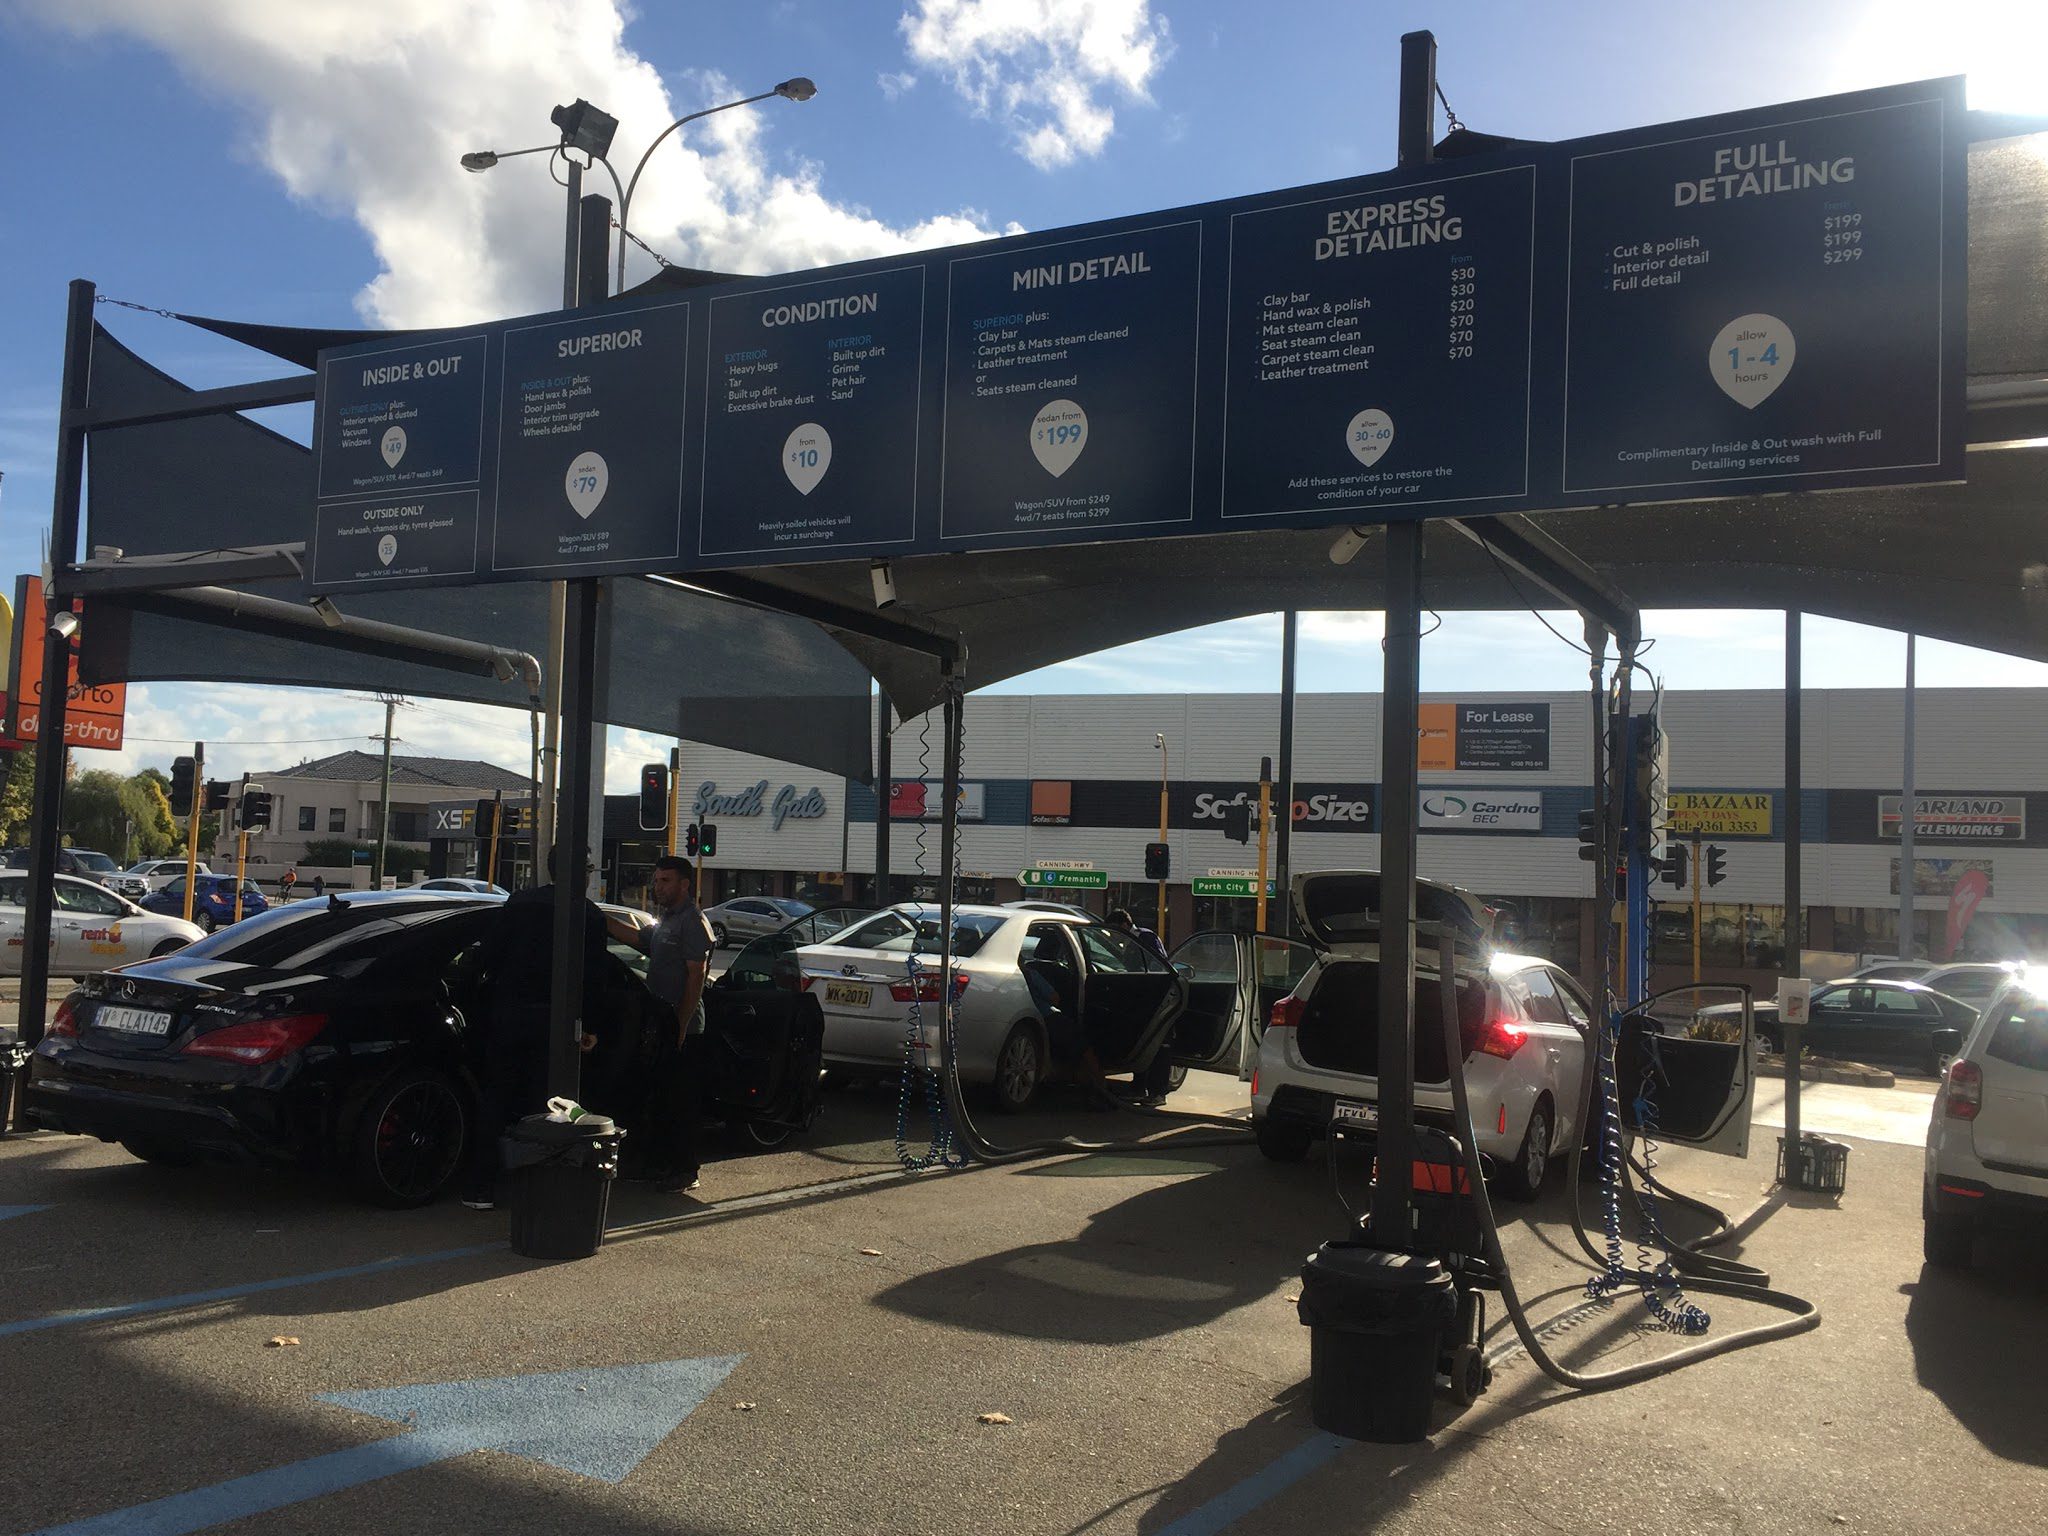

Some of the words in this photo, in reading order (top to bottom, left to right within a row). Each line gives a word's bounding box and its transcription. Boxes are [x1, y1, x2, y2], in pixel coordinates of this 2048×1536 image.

[1715, 140, 1796, 175] FULL
[1674, 157, 1855, 207] DETAILING
[1328, 195, 1446, 235] EXPRESS
[1824, 214, 1862, 230] $199
[1315, 217, 1463, 261] DETAILING
[1824, 231, 1862, 247] $199
[1613, 245, 1639, 259] Cut
[1642, 242, 1653, 255] &
[1656, 236, 1700, 256] polish
[1613, 260, 1666, 275] Interior
[1668, 251, 1709, 268] detail
[1824, 248, 1863, 264] $299
[1013, 264, 1062, 291] MINI
[1069, 252, 1151, 283] DETAIL
[1451, 267, 1475, 281] $30
[1613, 277, 1638, 291] Full
[1641, 271, 1681, 287] detail
[1450, 283, 1475, 297] $30
[1263, 294, 1288, 308] Clay
[1291, 292, 1310, 304] bar
[1450, 299, 1474, 313] $20
[762, 293, 878, 327] CONDITION
[1263, 308, 1293, 321] Hand
[1296, 307, 1320, 317] wax
[1323, 302, 1332, 314] &
[1334, 298, 1371, 316] polish
[973, 314, 1024, 330] SUPERIOR
[1026, 312, 1050, 325] plus:
[1263, 324, 1285, 337] Mat
[1287, 320, 1324, 333] steam
[1326, 315, 1358, 328] clean
[1450, 314, 1474, 328] $70
[558, 329, 643, 358] SUPERIOR
[828, 335, 872, 349] INTERIOR
[978, 331, 999, 344] Clay
[1002, 330, 1017, 340] bar
[978, 343, 1016, 357] Carpets
[1018, 340, 1026, 351] &
[1028, 339, 1053, 349] Mats
[1055, 334, 1086, 346] steam
[1088, 326, 1129, 342] cleaned
[1262, 338, 1289, 351] Seat
[1290, 334, 1327, 348] steam
[1329, 330, 1361, 343] clean
[1449, 330, 1473, 344] $70
[1736, 330, 1767, 342] allow
[725, 350, 768, 363] EXTERIOR
[833, 351, 853, 362] Built
[855, 351, 867, 360] up
[868, 347, 885, 357] dirt
[978, 357, 1015, 370] Leather
[1017, 350, 1068, 365] treatment
[1262, 352, 1301, 367] Carpet
[1303, 348, 1340, 361] steam
[1343, 344, 1375, 356] clean
[1449, 346, 1473, 360] $70
[363, 364, 410, 387] INSIDE
[413, 362, 424, 379] &
[427, 356, 462, 376] OUT
[729, 364, 756, 375] Heavy
[757, 361, 778, 373] bugs
[832, 363, 860, 374] Grime
[1261, 366, 1305, 381] Leather
[1308, 358, 1369, 376] treatment
[729, 378, 742, 388] Tar
[831, 377, 847, 388] Pet
[849, 375, 866, 385] hair
[976, 375, 986, 383] or
[1735, 372, 1769, 383] hours
[728, 389, 747, 400] Built
[749, 389, 761, 399] up
[762, 386, 777, 396] dirt
[976, 384, 1004, 397] Seats
[1005, 381, 1036, 393] steam
[1038, 375, 1077, 389] cleaned
[831, 389, 853, 400] Sand
[524, 404, 543, 413] Door
[543, 401, 566, 413] jambs
[728, 400, 768, 413] Excessive
[769, 397, 793, 408] brake
[794, 394, 814, 405] dust
[524, 415, 551, 425] Interior
[552, 413, 567, 422] trim
[569, 408, 600, 422] upgrade
[1037, 413, 1060, 423] sedan
[1062, 412, 1081, 421] from
[342, 428, 368, 436] Vacuum
[523, 426, 550, 437] Wheels
[552, 423, 582, 434] detailed
[341, 437, 371, 448] Windows
[799, 438, 816, 447] from
[1617, 445, 1709, 462] Complimentary
[1712, 441, 1748, 454] Inside
[1751, 439, 1761, 450] &
[1763, 438, 1788, 449] Out
[1791, 434, 1823, 447] wash
[1826, 432, 1855, 445] with
[1858, 429, 1881, 441] Full
[1691, 457, 1746, 471] Detailing
[1749, 453, 1800, 466] services
[1288, 478, 1308, 489] Add
[1310, 476, 1338, 486] these
[1340, 473, 1380, 484] services
[1382, 472, 1394, 481] to
[1396, 469, 1432, 479] restore
[1434, 466, 1452, 476] the
[1317, 488, 1364, 500] condition
[1366, 485, 1379, 496] of
[1379, 485, 1403, 497] your
[1404, 484, 1421, 494] car
[1015, 498, 1065, 511] Wagon/SUV
[1066, 497, 1087, 506] from
[1088, 494, 1110, 505] $249
[363, 507, 400, 520] OUTSIDE
[401, 505, 424, 516] ONLY
[1466, 711, 1489, 722] For
[1493, 711, 1534, 722] Lease
[692, 780, 768, 817] South
[772, 784, 827, 831] Gate
[1472, 802, 1539, 815] Cardno
[1687, 795, 1768, 810] BAZAAR
[1899, 800, 2004, 815] ARLAND
[1473, 815, 1499, 824] BEC
[1673, 811, 1699, 819] OPEN
[1712, 812, 1740, 820] DAYS
[1697, 821, 1723, 832] 9361
[1729, 822, 1757, 832] 3353
[1898, 824, 2004, 836] CLEWORKS
[1059, 875, 1101, 883] Fremantle
[1199, 882, 1222, 890] Perth
[1226, 883, 1244, 892] City
[119, 1011, 169, 1034] CLA1145
